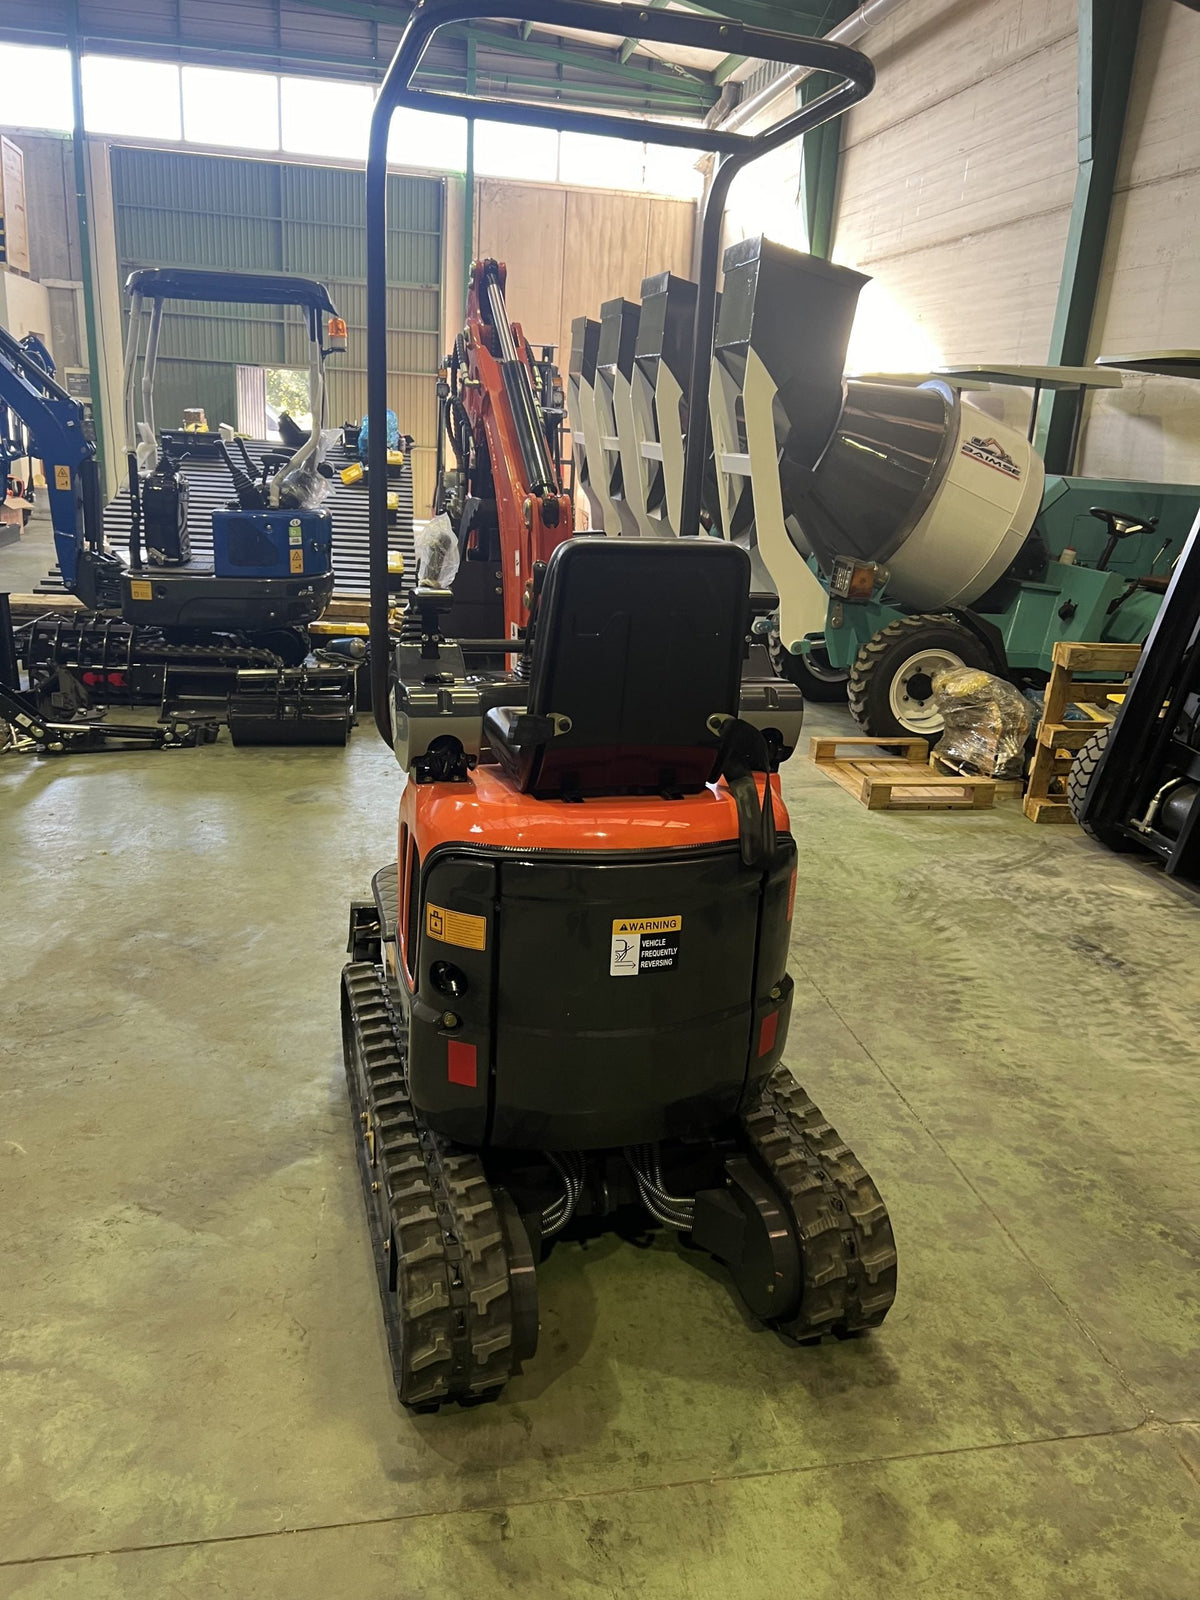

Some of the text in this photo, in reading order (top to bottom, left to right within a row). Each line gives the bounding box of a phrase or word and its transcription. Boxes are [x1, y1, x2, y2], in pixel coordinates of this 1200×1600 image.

[629, 919, 677, 931] WARNING
[641, 938, 667, 947] VEHICLE
[641, 947, 678, 958] FREQUENTLY
[640, 958, 673, 969] REVERSING
